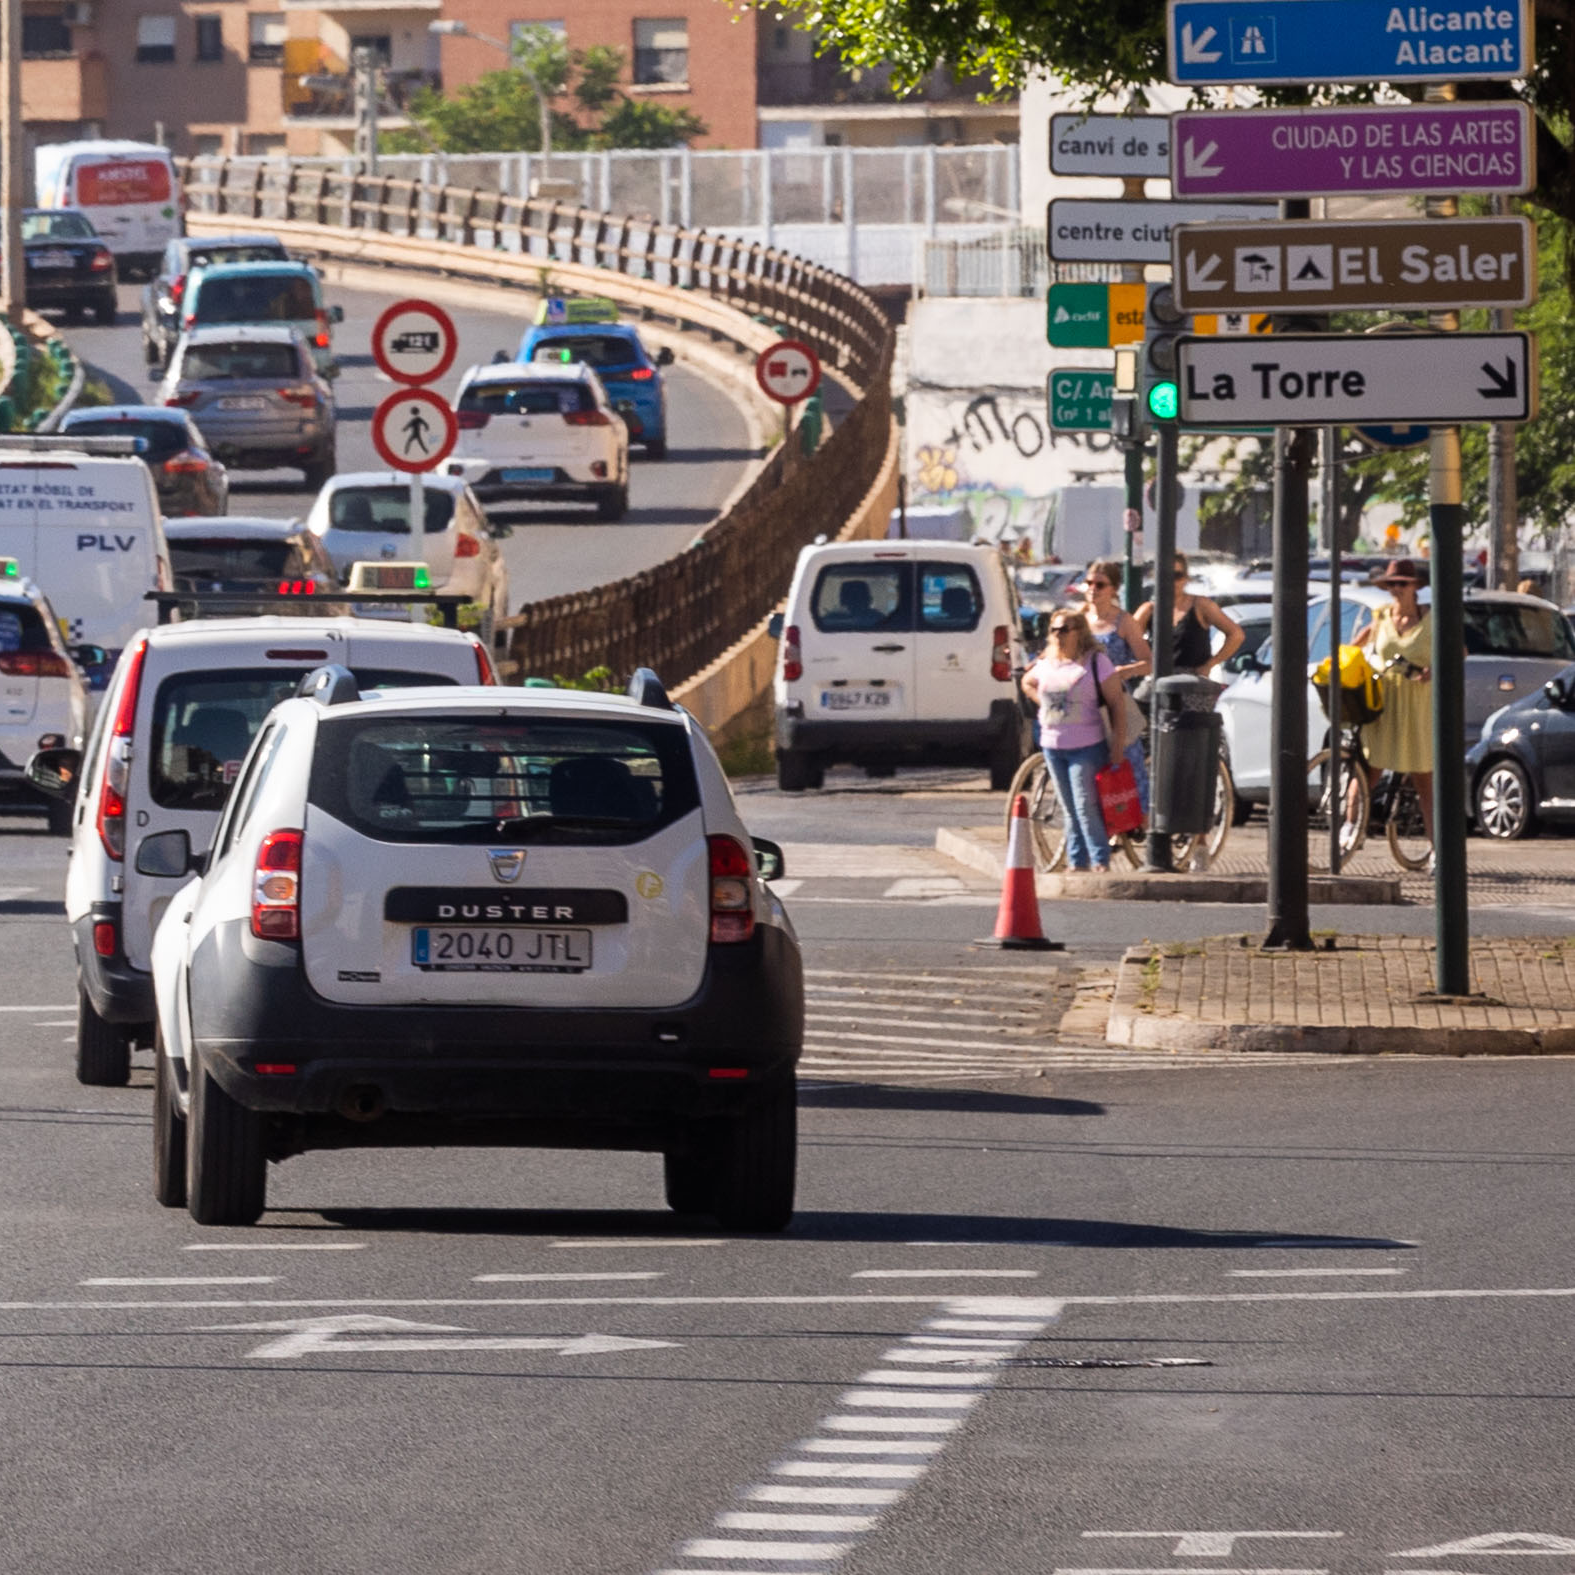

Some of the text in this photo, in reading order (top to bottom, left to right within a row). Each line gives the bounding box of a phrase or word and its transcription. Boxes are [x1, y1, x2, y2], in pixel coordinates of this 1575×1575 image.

[1386, 4, 1514, 34] Alicante
[1395, 37, 1514, 66] Alacant
[1123, 137, 1149, 157] de
[1272, 120, 1515, 150] CIUDAD DE LAS ARTES
[1340, 152, 1515, 179] Y LAS CIENCIAS
[1057, 222, 1124, 241] centre
[1339, 244, 1518, 284] El Saler
[1186, 362, 1366, 401] La Torre
[77, 485, 95, 496] DE
[17, 499, 35, 510] EN
[38, 499, 54, 510] EL
[58, 500, 135, 512] TRANSPORT
[76, 534, 136, 552] PLV
[438, 904, 574, 919] DUSTER
[436, 932, 582, 962] 2040 JTL
